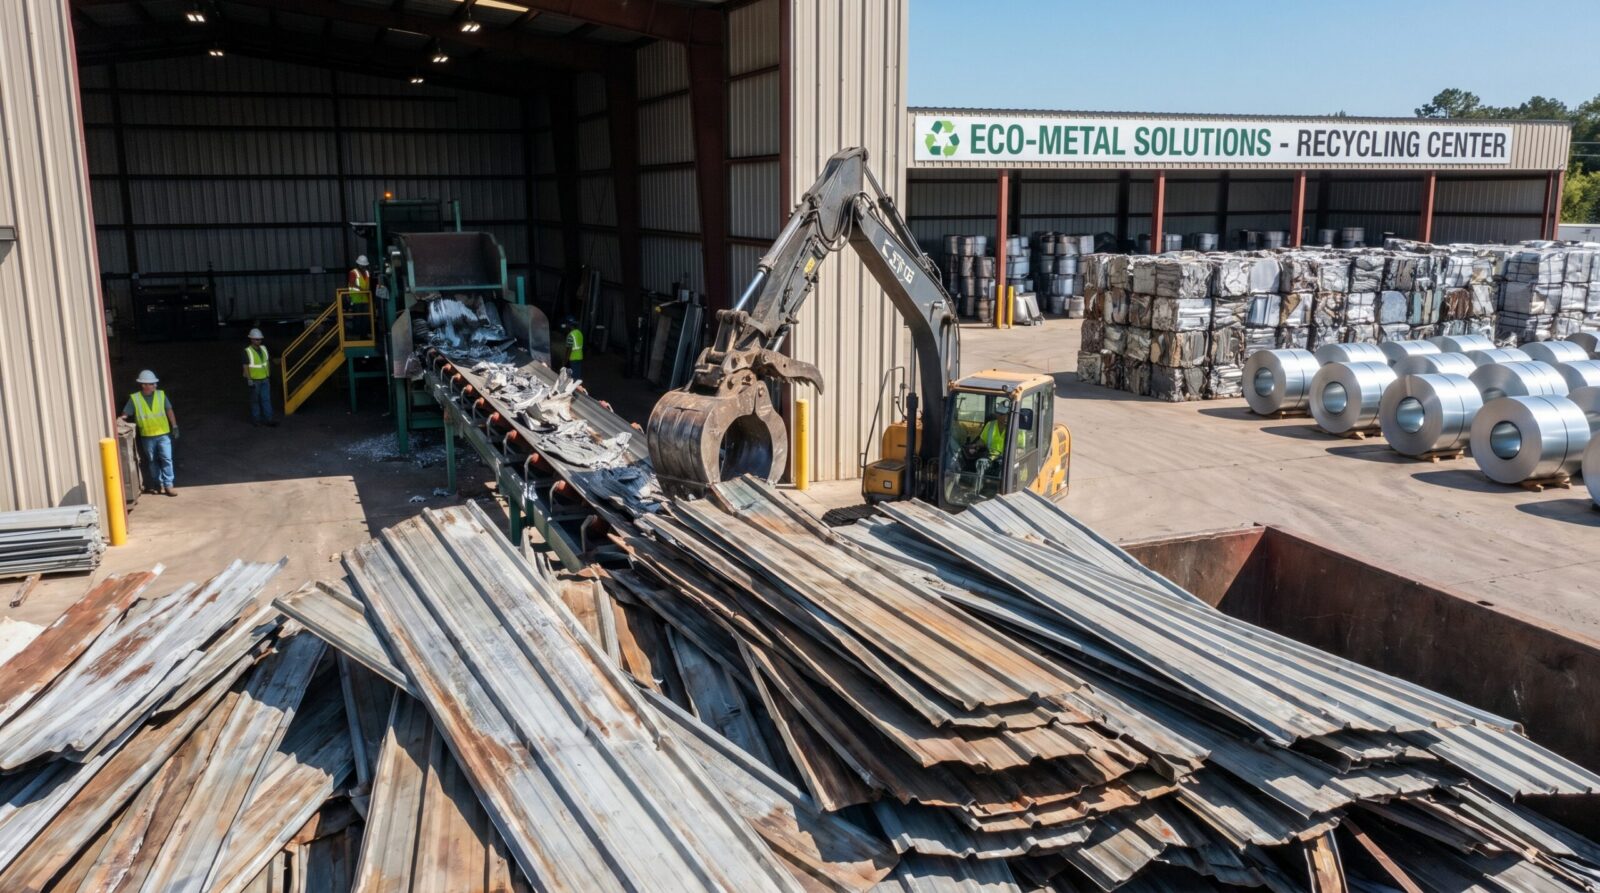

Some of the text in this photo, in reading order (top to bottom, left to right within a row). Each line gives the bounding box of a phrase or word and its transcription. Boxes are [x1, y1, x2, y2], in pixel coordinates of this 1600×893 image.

[971, 124, 1126, 155] ECO-METAL
[1134, 127, 1271, 156] SOLUTIONS
[1297, 130, 1420, 157] RECYCLING
[1428, 131, 1506, 157] CENTER
